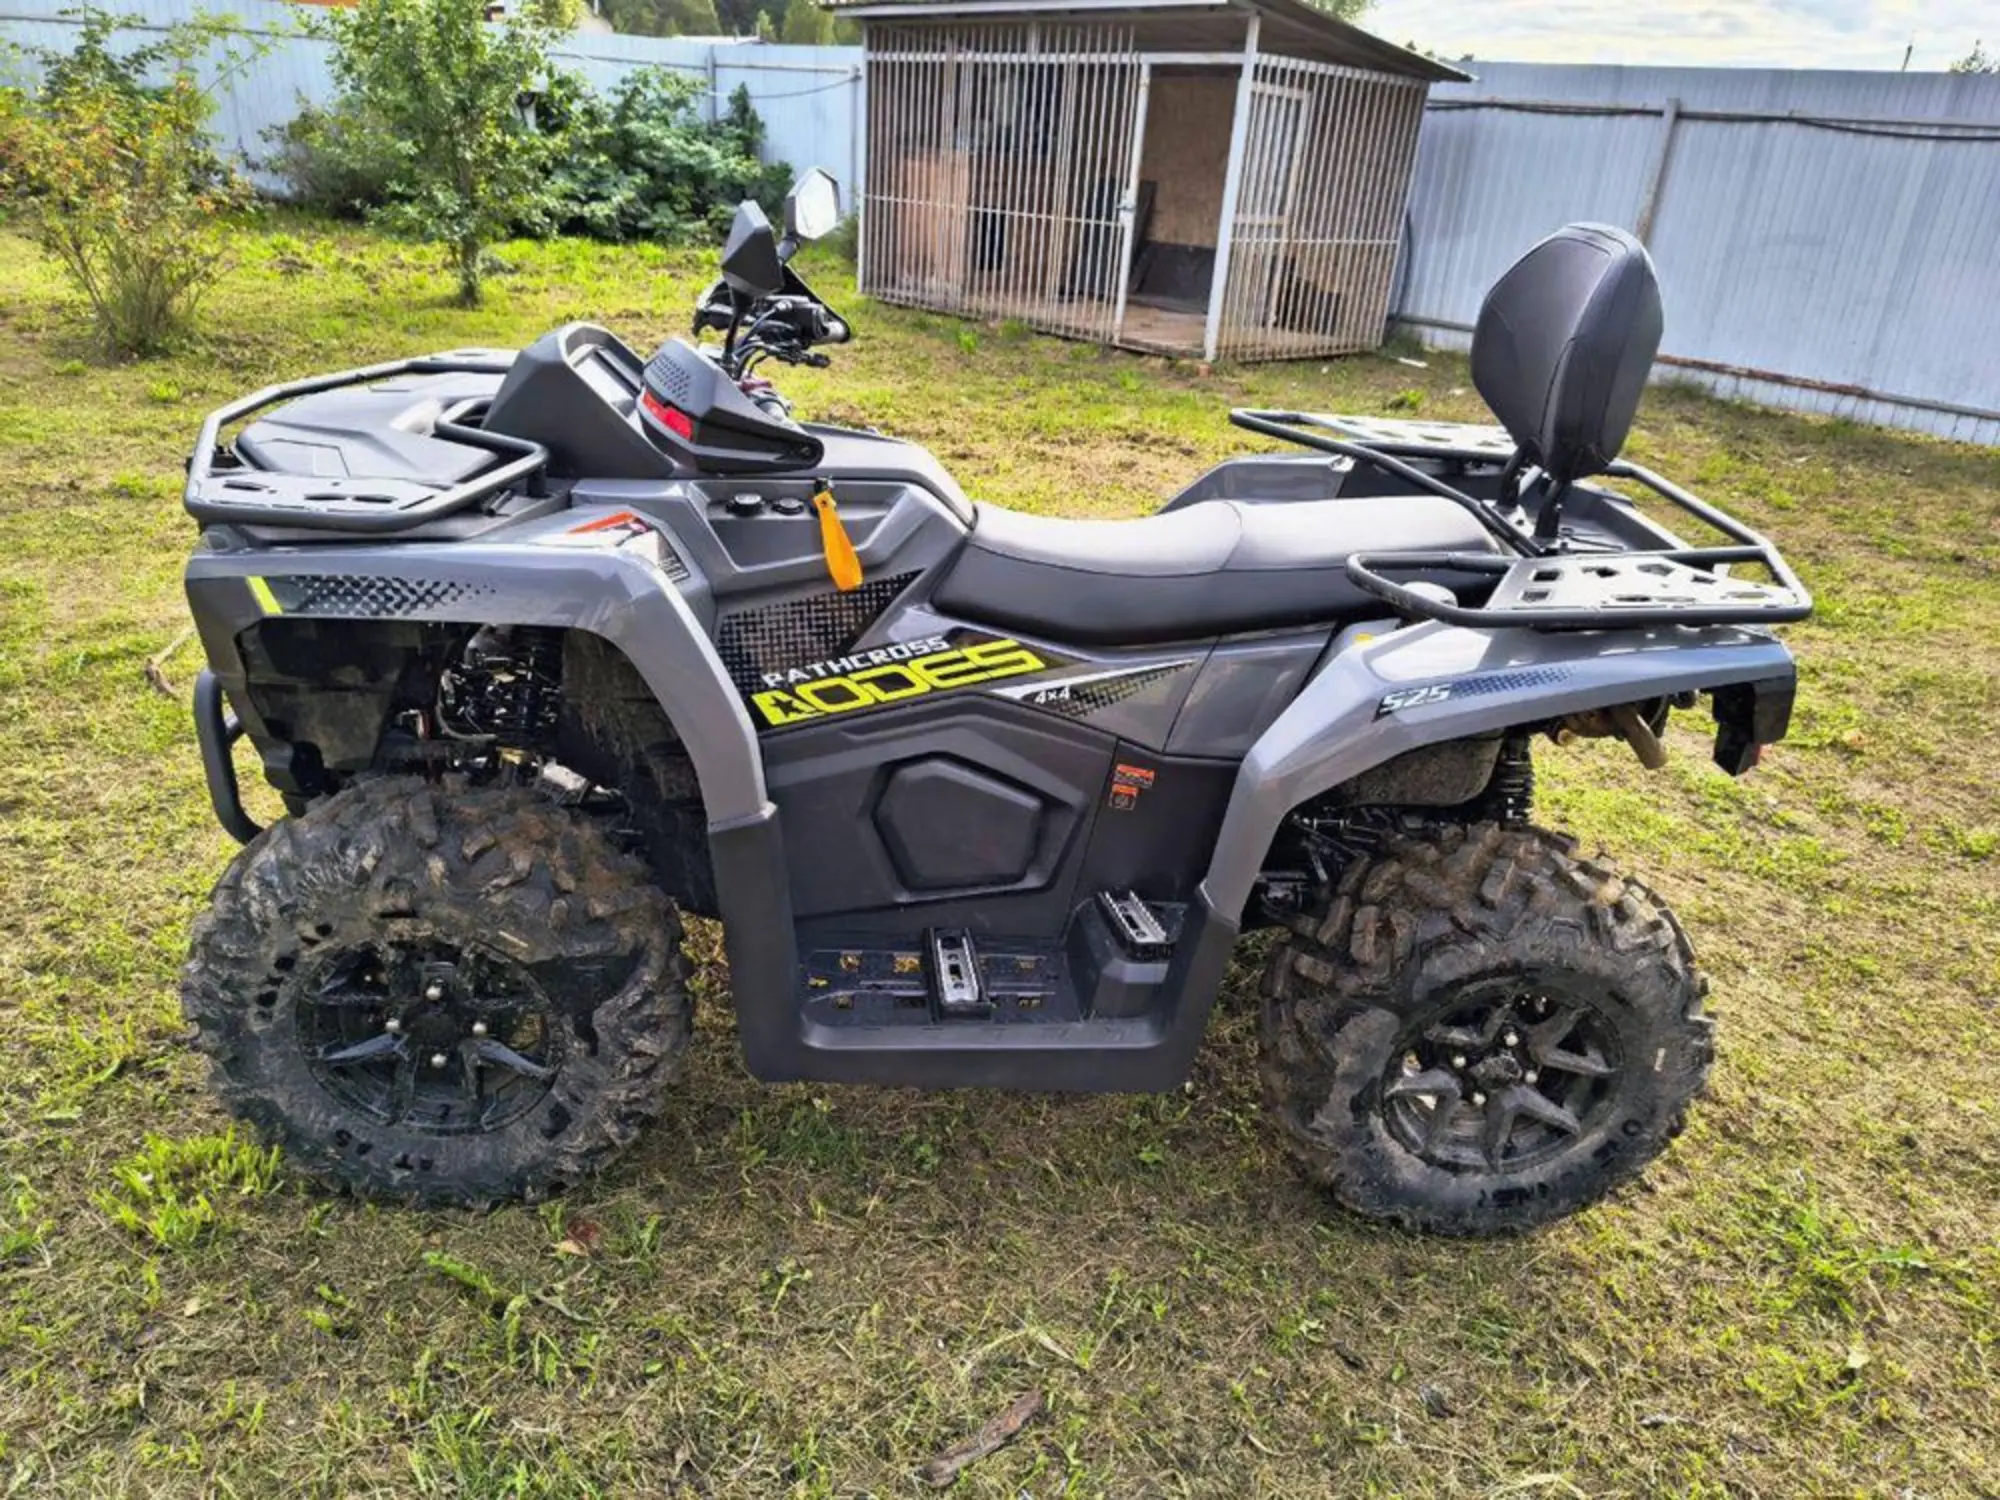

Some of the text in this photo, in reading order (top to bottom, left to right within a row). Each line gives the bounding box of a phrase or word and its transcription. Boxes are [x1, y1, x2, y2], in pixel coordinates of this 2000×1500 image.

[751, 639, 1045, 725] AODES
[763, 638, 950, 688] PATHCROSS
[1379, 684, 1451, 713] 525
